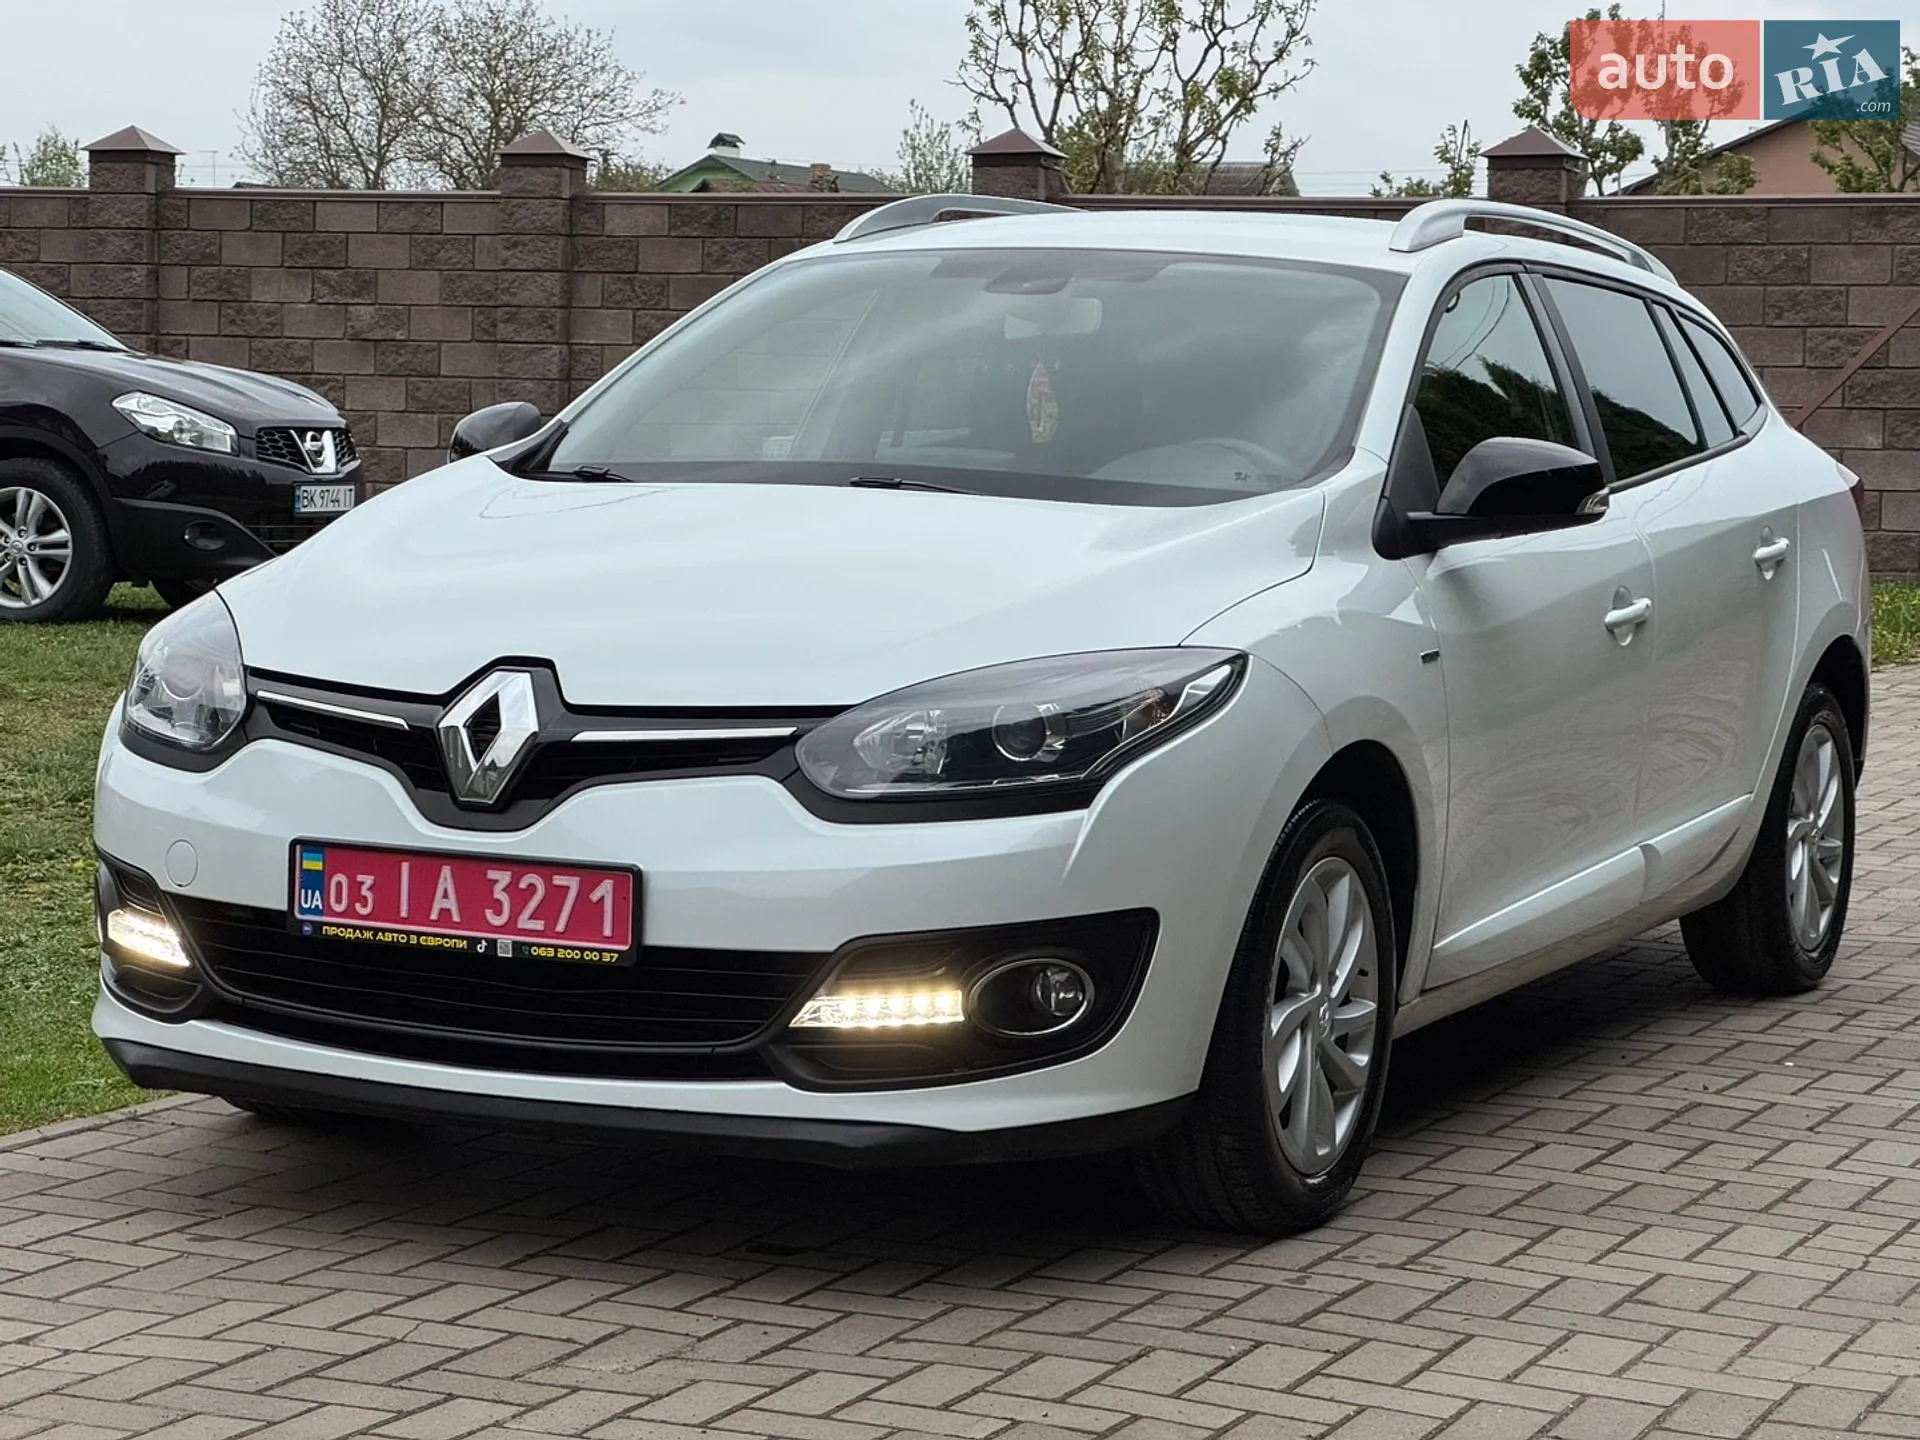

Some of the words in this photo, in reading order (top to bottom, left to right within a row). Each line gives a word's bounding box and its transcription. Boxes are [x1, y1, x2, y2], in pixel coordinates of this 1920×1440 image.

[302, 489, 316, 508] BK
[300, 888, 323, 910] UA
[329, 873, 376, 916] 03
[484, 869, 615, 938] 3271
[322, 926, 374, 941] ПРОДАЖ
[376, 932, 407, 944] АВТО
[419, 935, 468, 950] ЄВРОПИ
[530, 946, 555, 958] 063
[557, 948, 581, 960] 200
[583, 951, 600, 962] 00
[601, 952, 619, 963] 37
